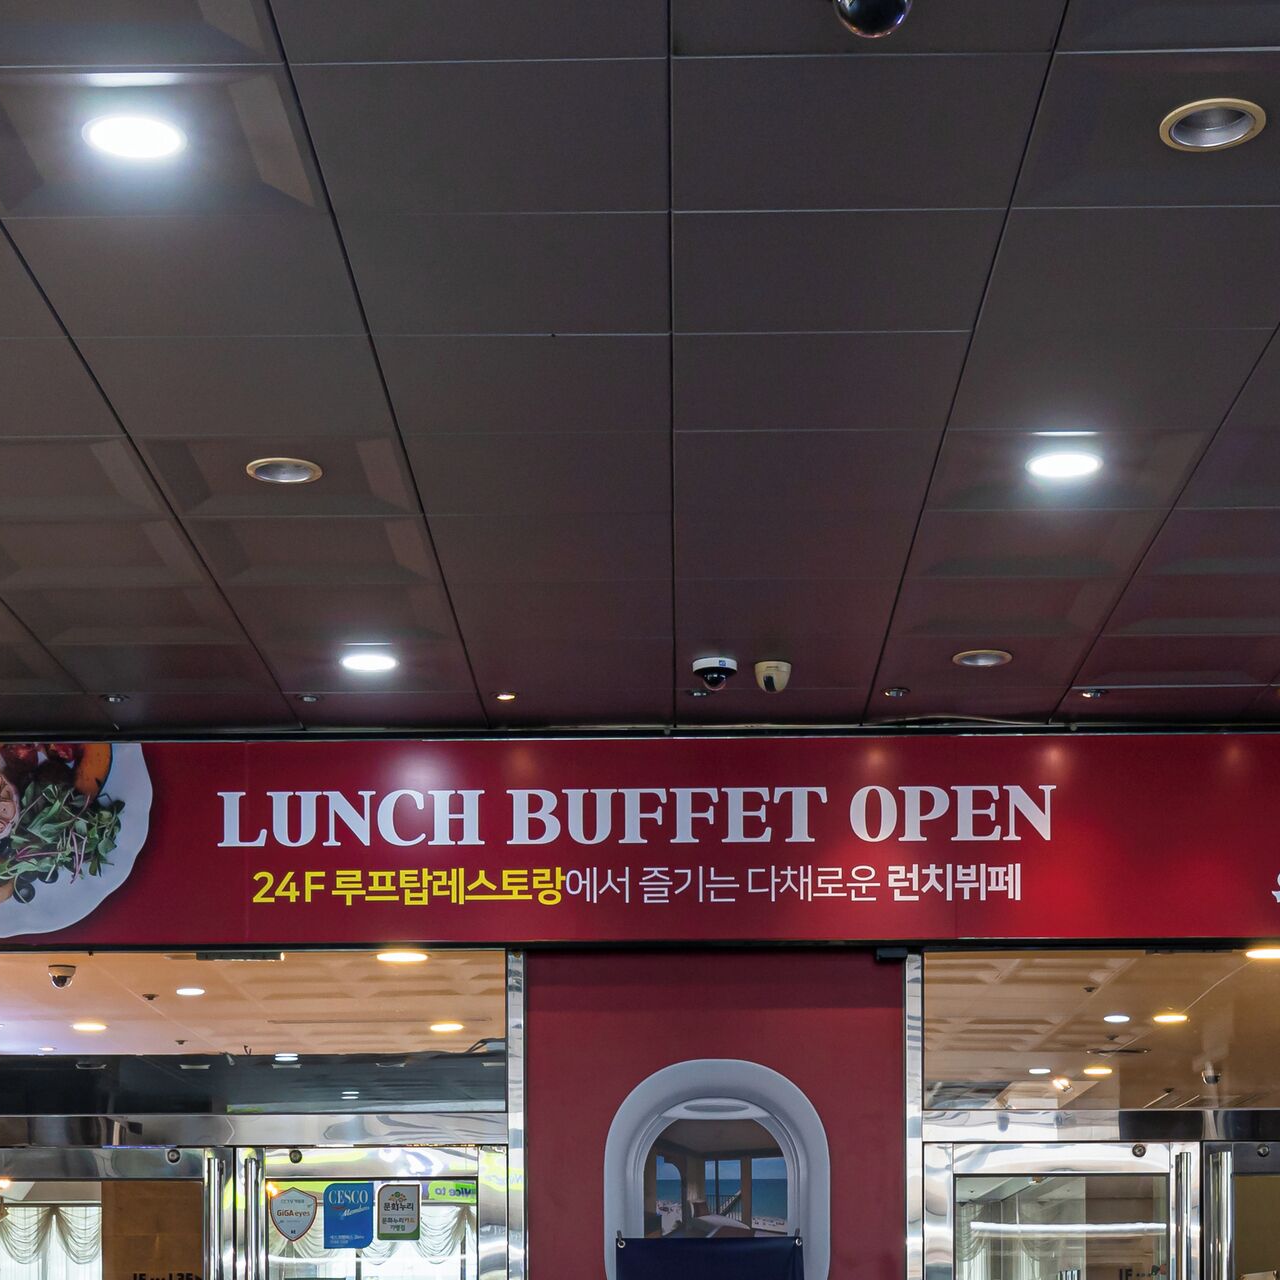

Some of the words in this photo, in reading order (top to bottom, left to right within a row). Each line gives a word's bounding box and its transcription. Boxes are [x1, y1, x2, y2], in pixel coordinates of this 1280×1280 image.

[217, 790, 485, 847] LUNCH
[506, 787, 828, 844] BUFFET
[849, 785, 1056, 842] OPEN
[252, 871, 326, 903] 24F
[332, 867, 630, 905] 루프탑레스토랑에서
[638, 866, 739, 903] 즐기는
[748, 864, 881, 902] 다채로운
[888, 863, 1022, 901] 런치뷔페
[328, 1190, 369, 1204] CESCO
[294, 1210, 311, 1218] eyes
[383, 1202, 414, 1212] 문화누리
